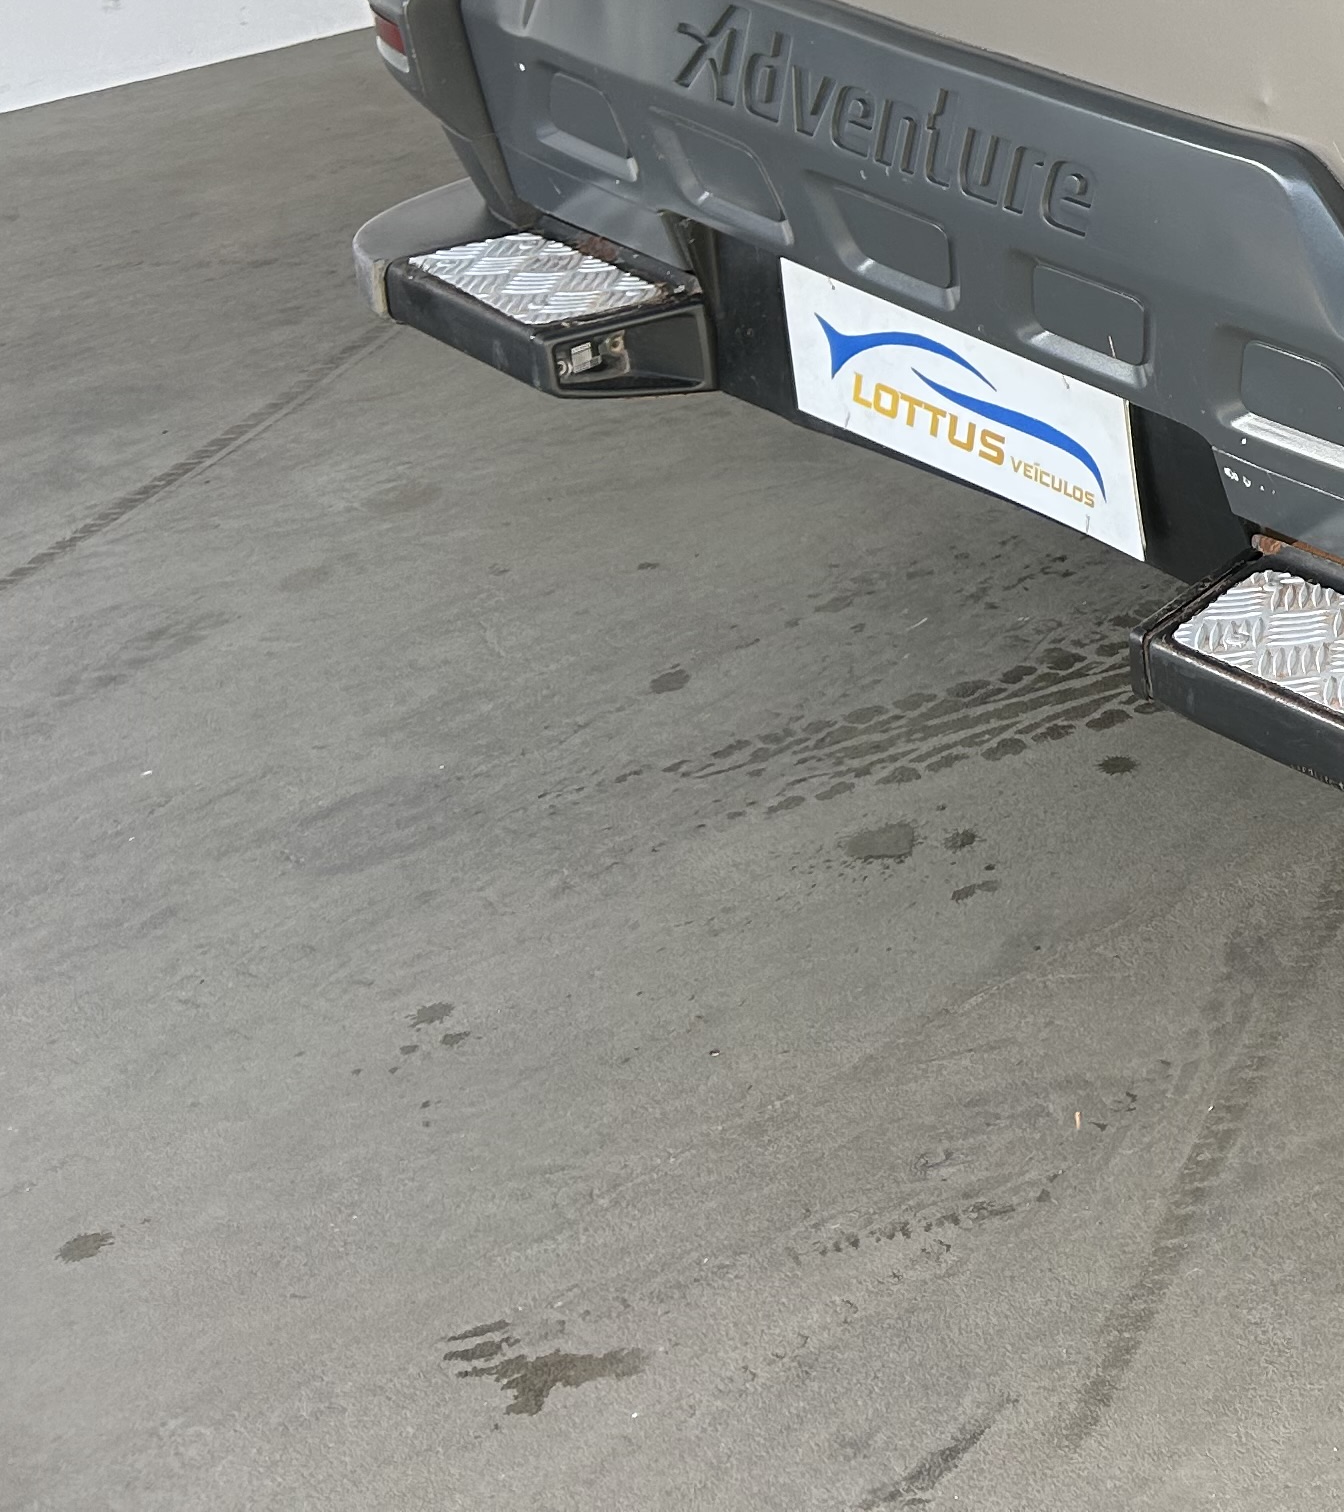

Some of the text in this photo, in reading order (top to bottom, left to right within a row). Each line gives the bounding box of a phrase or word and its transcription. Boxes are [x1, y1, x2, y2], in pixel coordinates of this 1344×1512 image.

[675, 4, 1095, 239] Adventure
[852, 371, 1096, 508] LOTTUS VEÍCULOS
